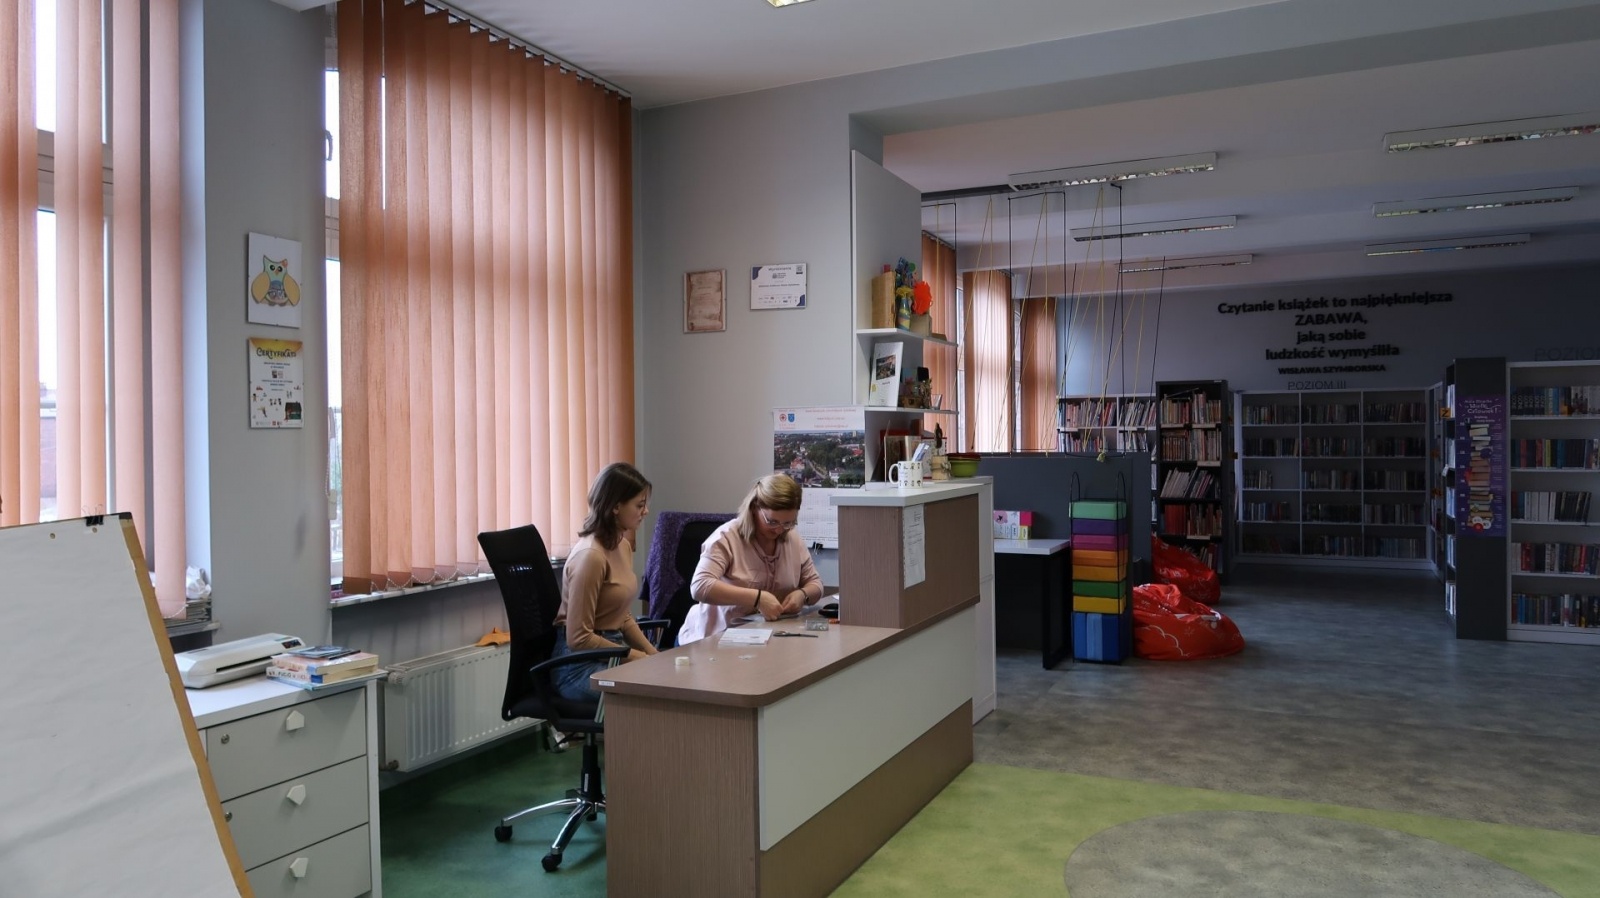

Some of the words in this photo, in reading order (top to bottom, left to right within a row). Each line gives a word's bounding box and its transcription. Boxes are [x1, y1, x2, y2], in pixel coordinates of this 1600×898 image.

[1217, 301, 1275, 315] Czytanie
[1278, 298, 1329, 312] książek
[1332, 297, 1347, 308] to
[1350, 292, 1453, 308] najpiękniejsza
[1295, 312, 1368, 326] ZABAWA,
[1297, 331, 1325, 345] jaką
[1328, 329, 1366, 341] sobie
[1265, 348, 1325, 361] ludzkość
[1328, 344, 1400, 359] wymyśliła
[1534, 346, 1600, 362] POZIO
[1278, 366, 1321, 375] WISŁAWA
[1322, 364, 1386, 374] SZYMBORSKA
[1287, 381, 1333, 391] POZIOM
[1336, 380, 1347, 390] III
